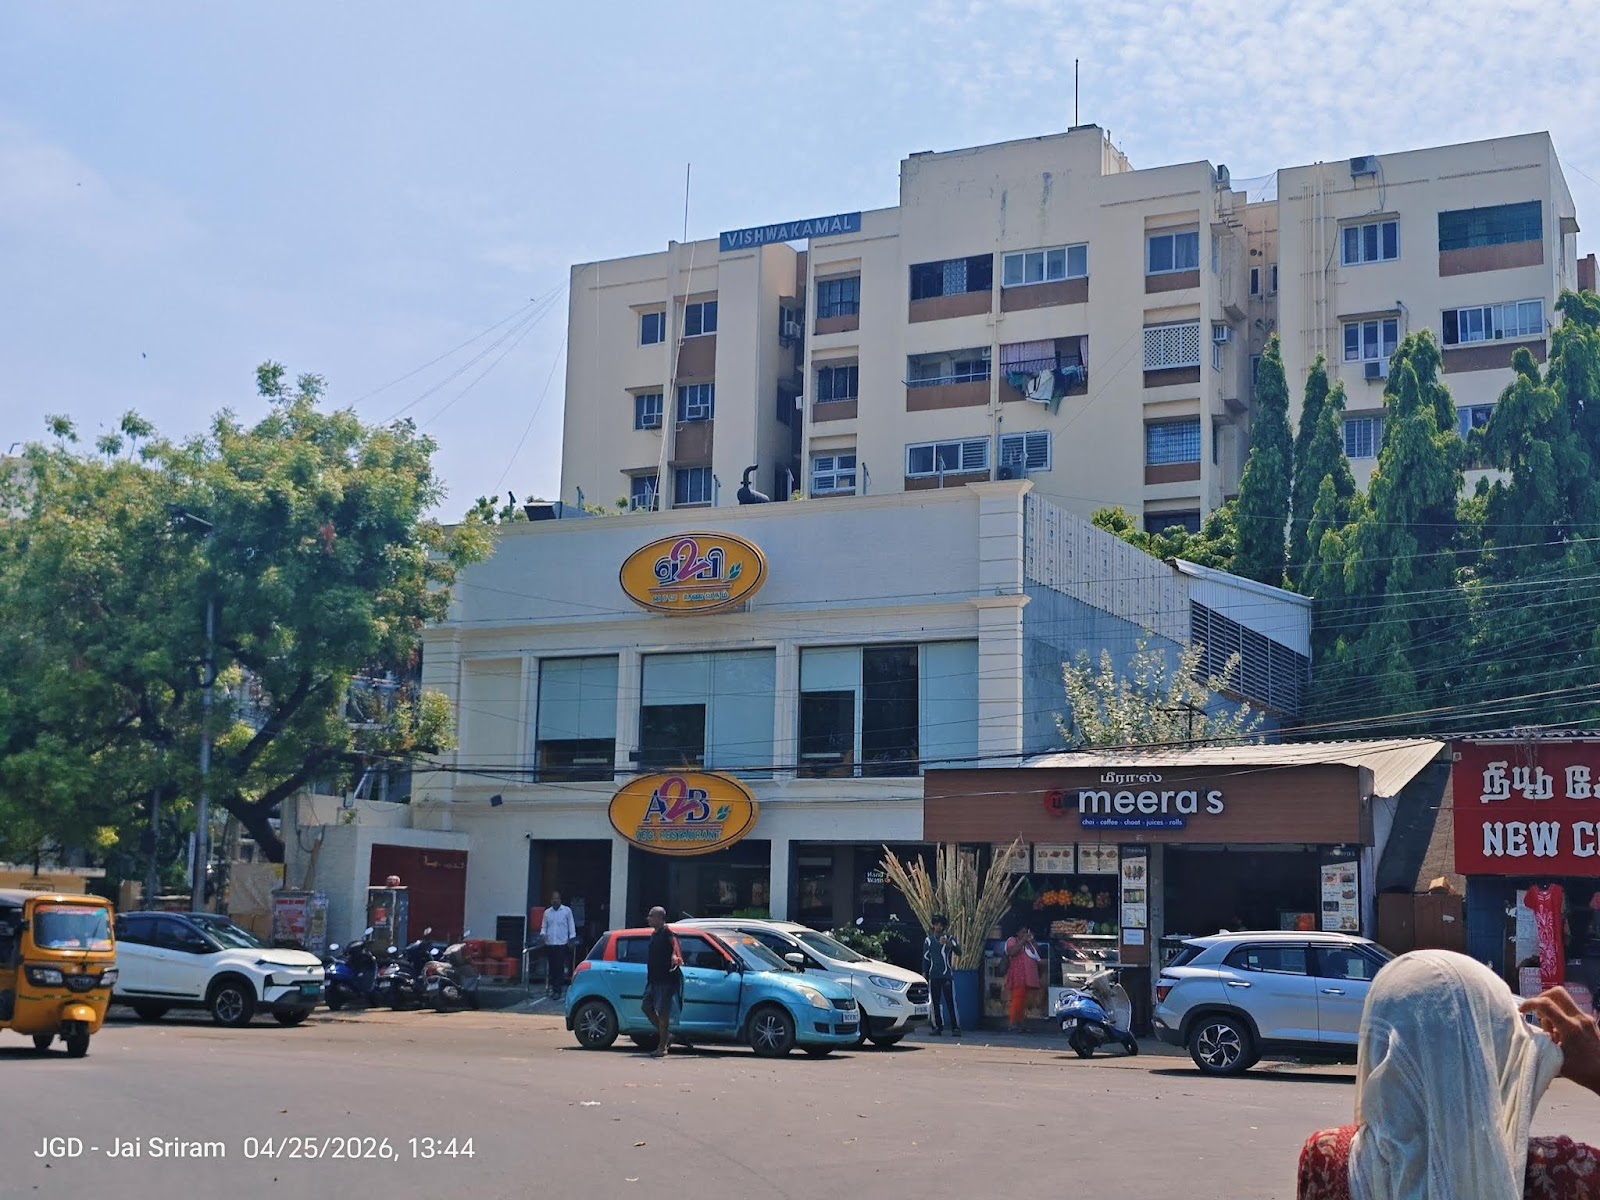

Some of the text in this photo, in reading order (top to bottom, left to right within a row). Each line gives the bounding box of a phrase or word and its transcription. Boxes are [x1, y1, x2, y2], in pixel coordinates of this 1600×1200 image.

[726, 215, 852, 247] VISHWAKAMAL
[642, 776, 711, 823] A2B
[1146, 818, 1164, 827] juices
[1482, 821, 1560, 857] NEW
